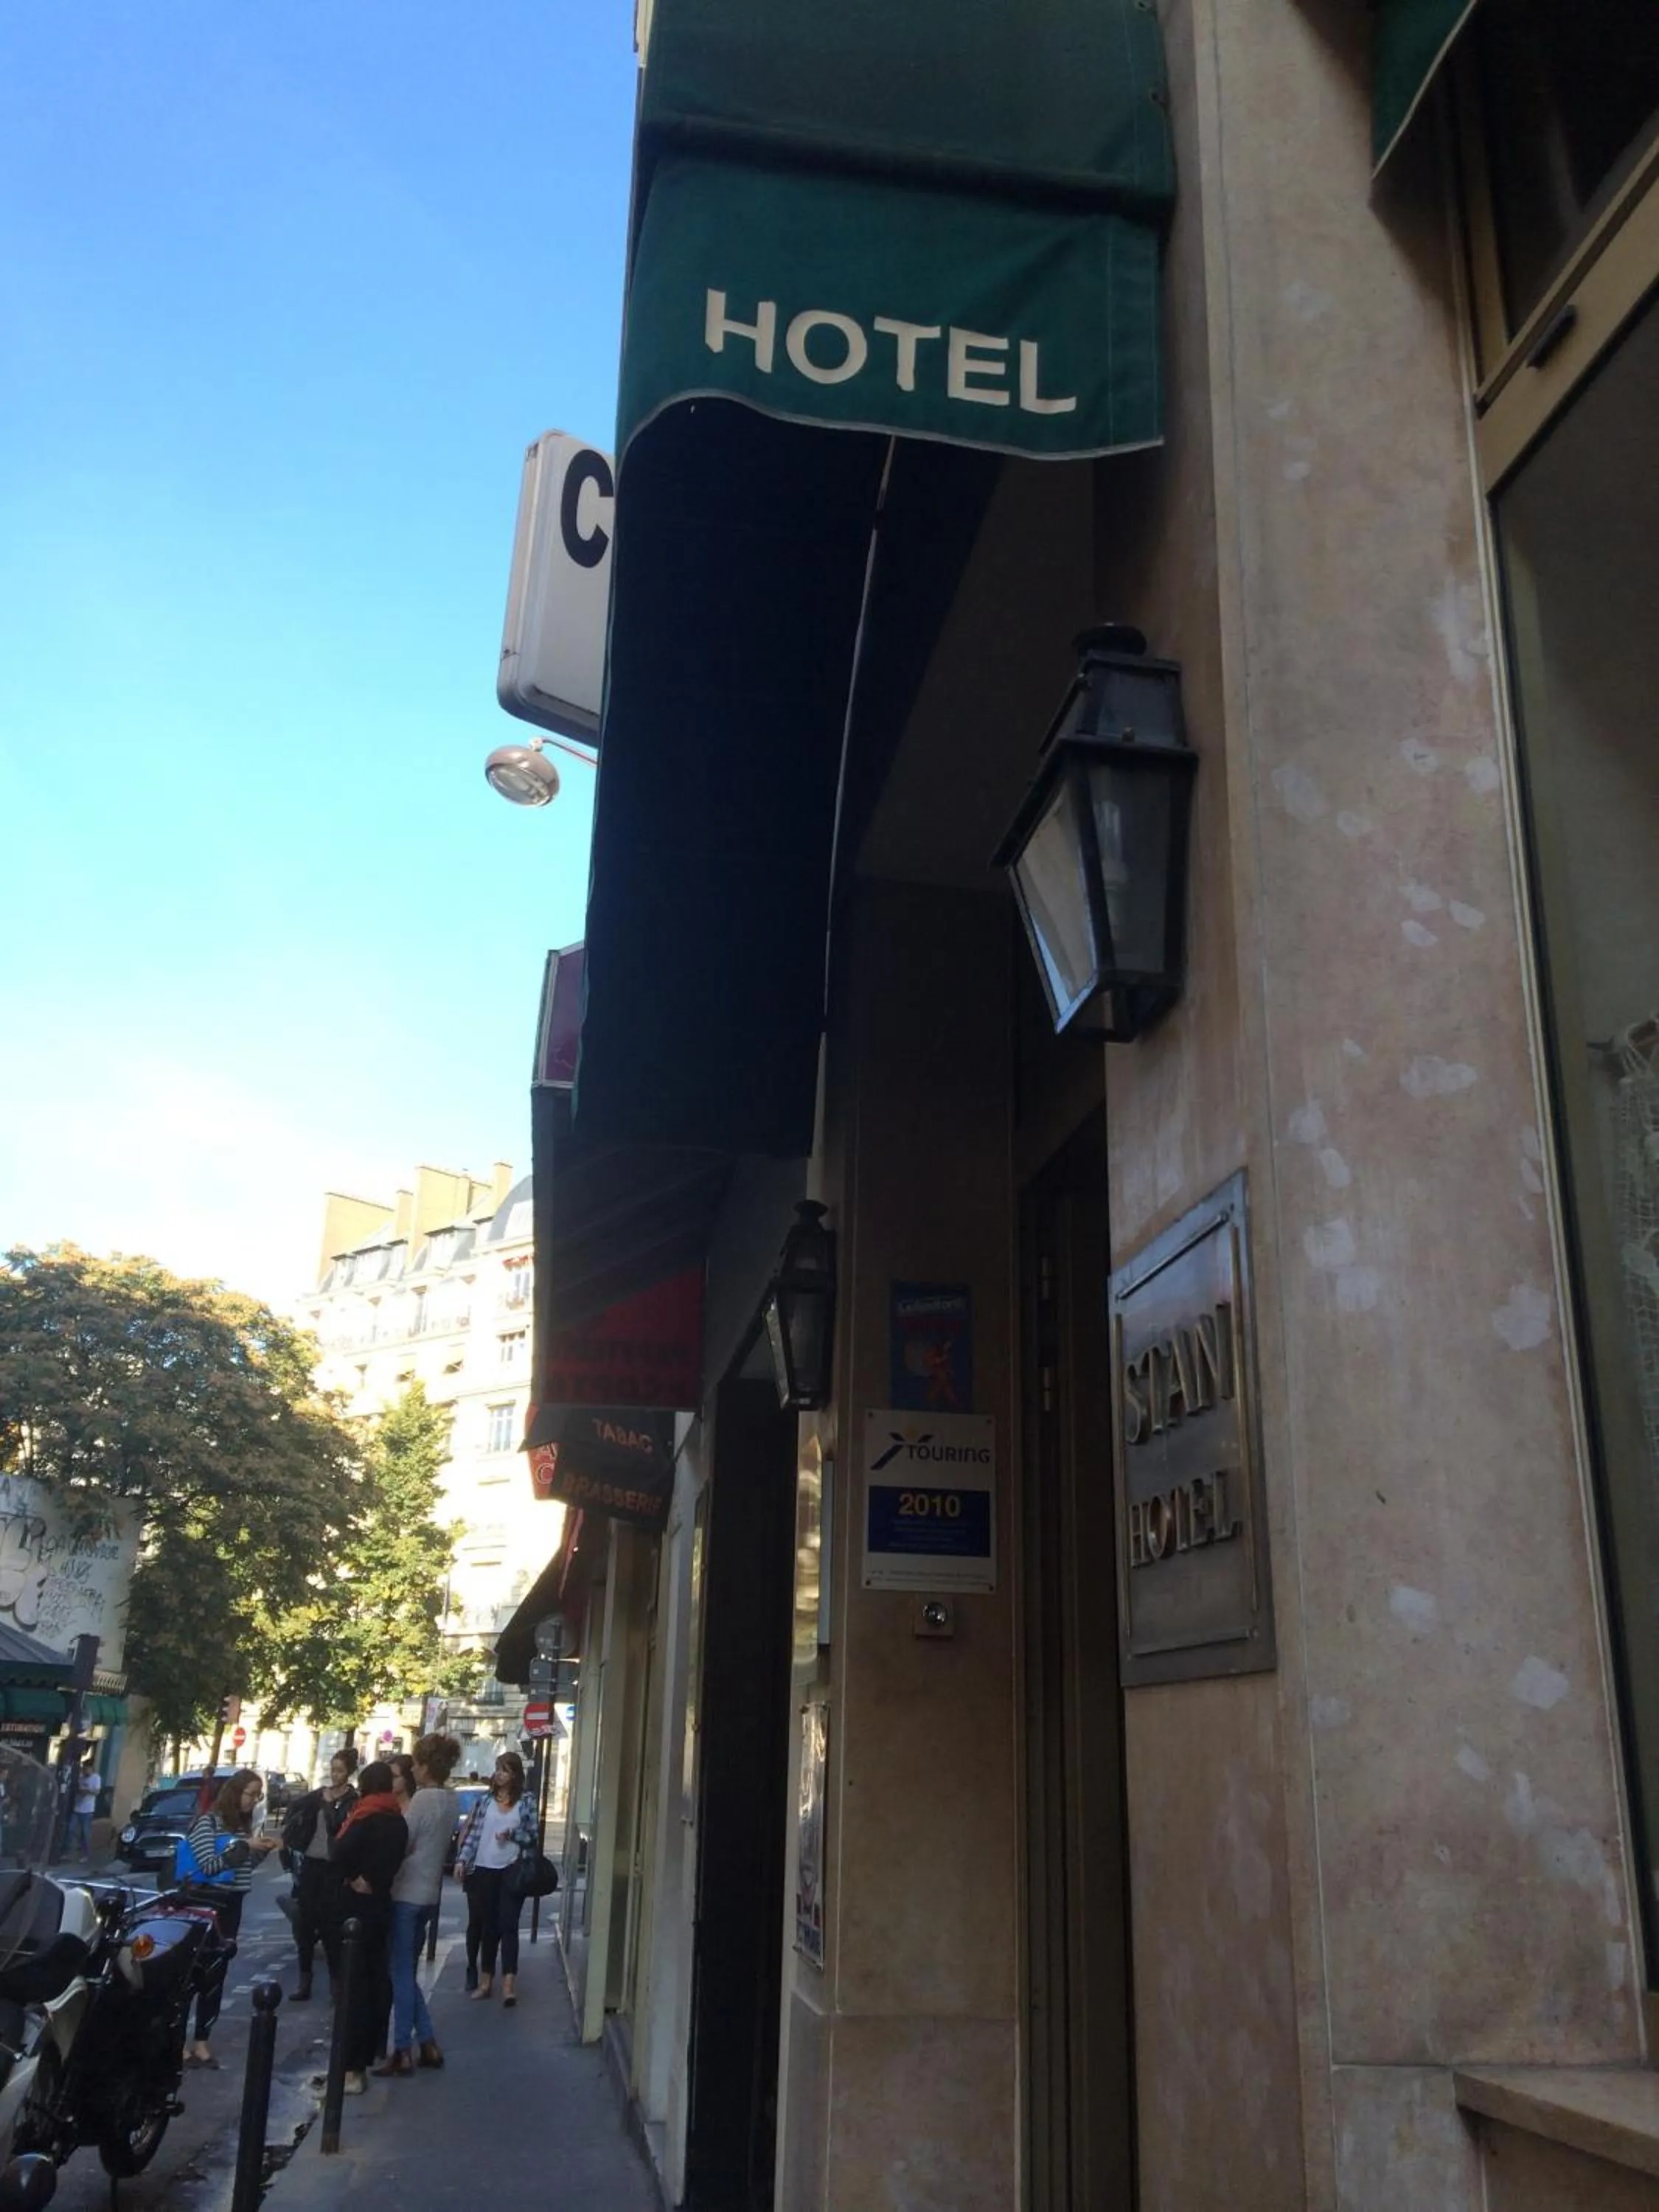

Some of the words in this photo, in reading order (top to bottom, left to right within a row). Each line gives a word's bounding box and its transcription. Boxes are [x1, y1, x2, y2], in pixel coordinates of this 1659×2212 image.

[705, 289, 1077, 414] HOTEL
[1124, 1301, 1234, 1444] STAN
[591, 1418, 653, 1454] TABAC
[907, 1444, 991, 1464] TOURING
[563, 1472, 662, 1514] BRASSERIE
[898, 1492, 962, 1518] 2010
[1130, 1471, 1242, 1568] HOTEL
